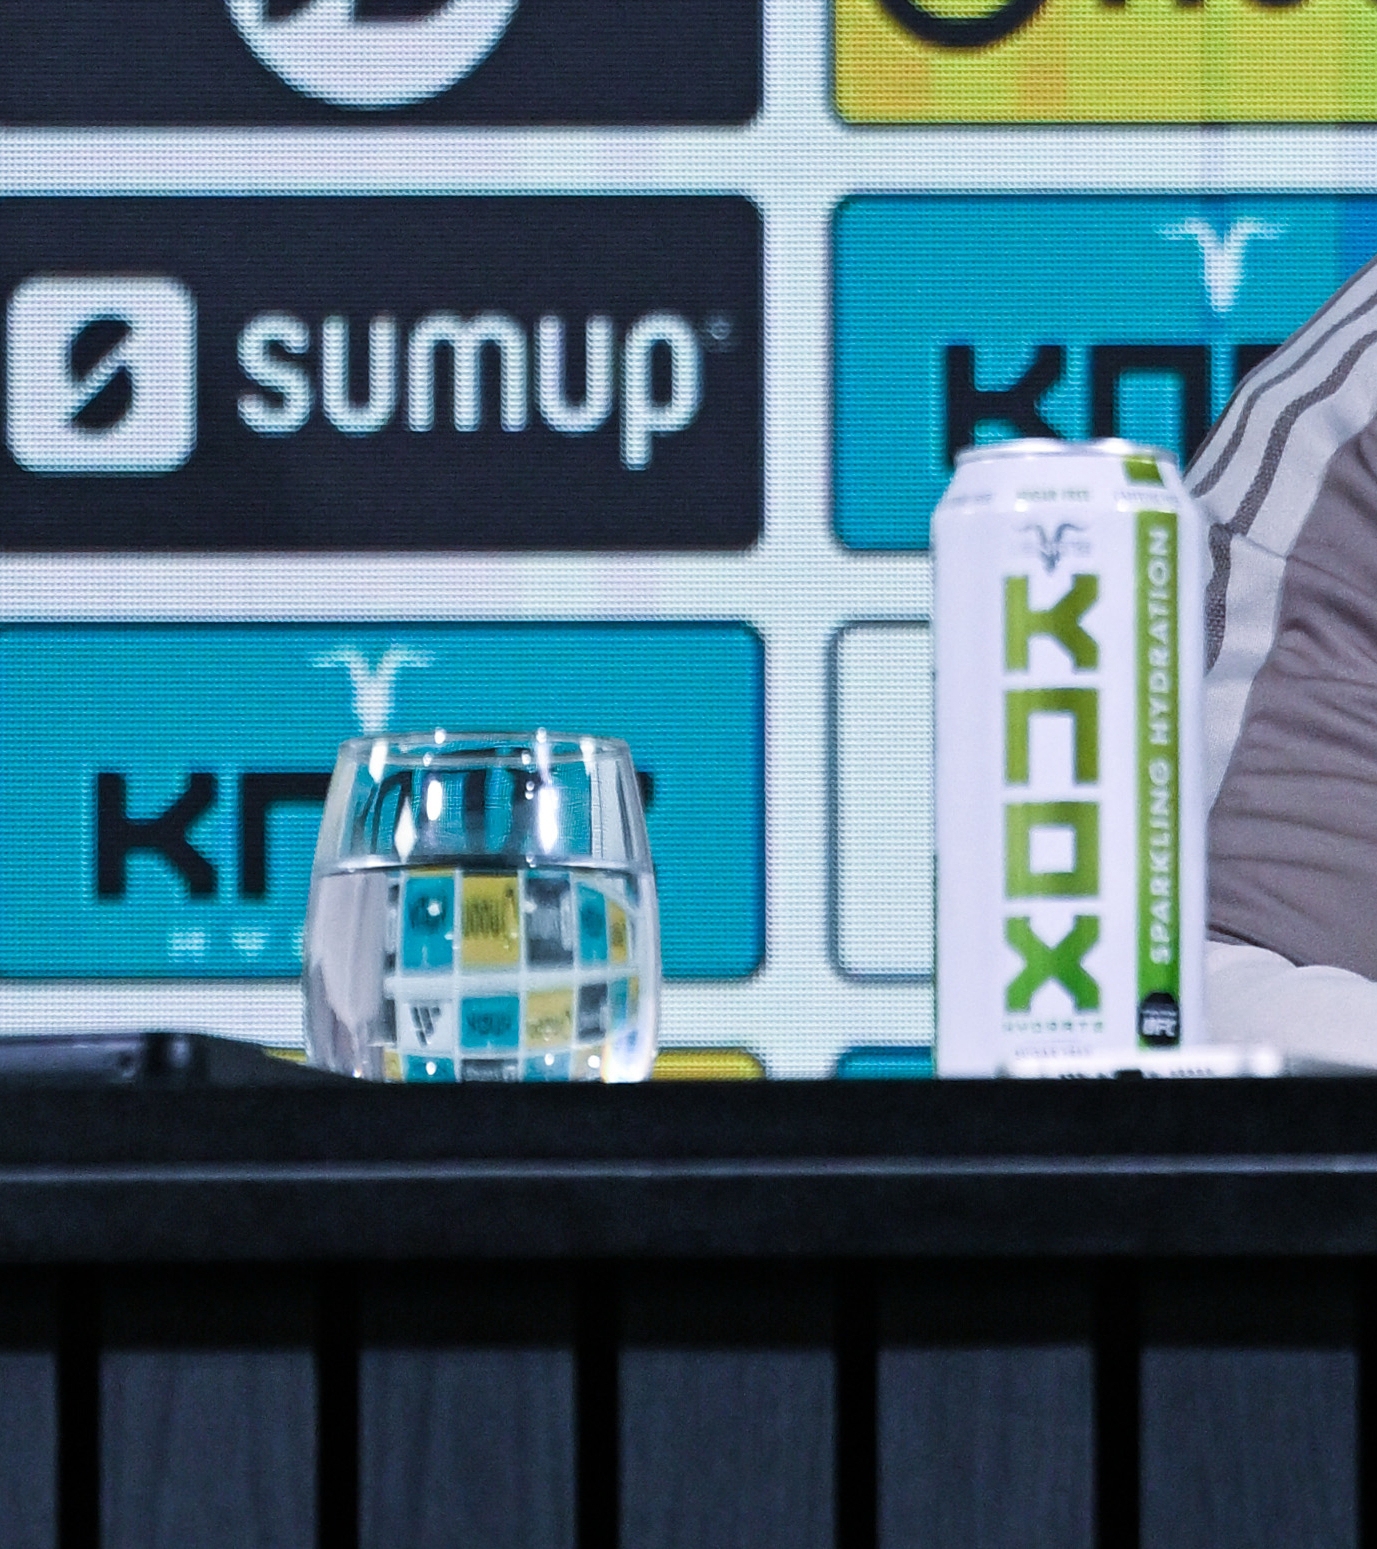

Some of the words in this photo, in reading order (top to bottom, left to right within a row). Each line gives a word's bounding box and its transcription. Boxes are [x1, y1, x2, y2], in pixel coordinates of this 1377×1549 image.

[238, 312, 703, 471] sumup
[1148, 528, 1172, 746] HYDRATION
[1149, 757, 1173, 966] SPARKLING
